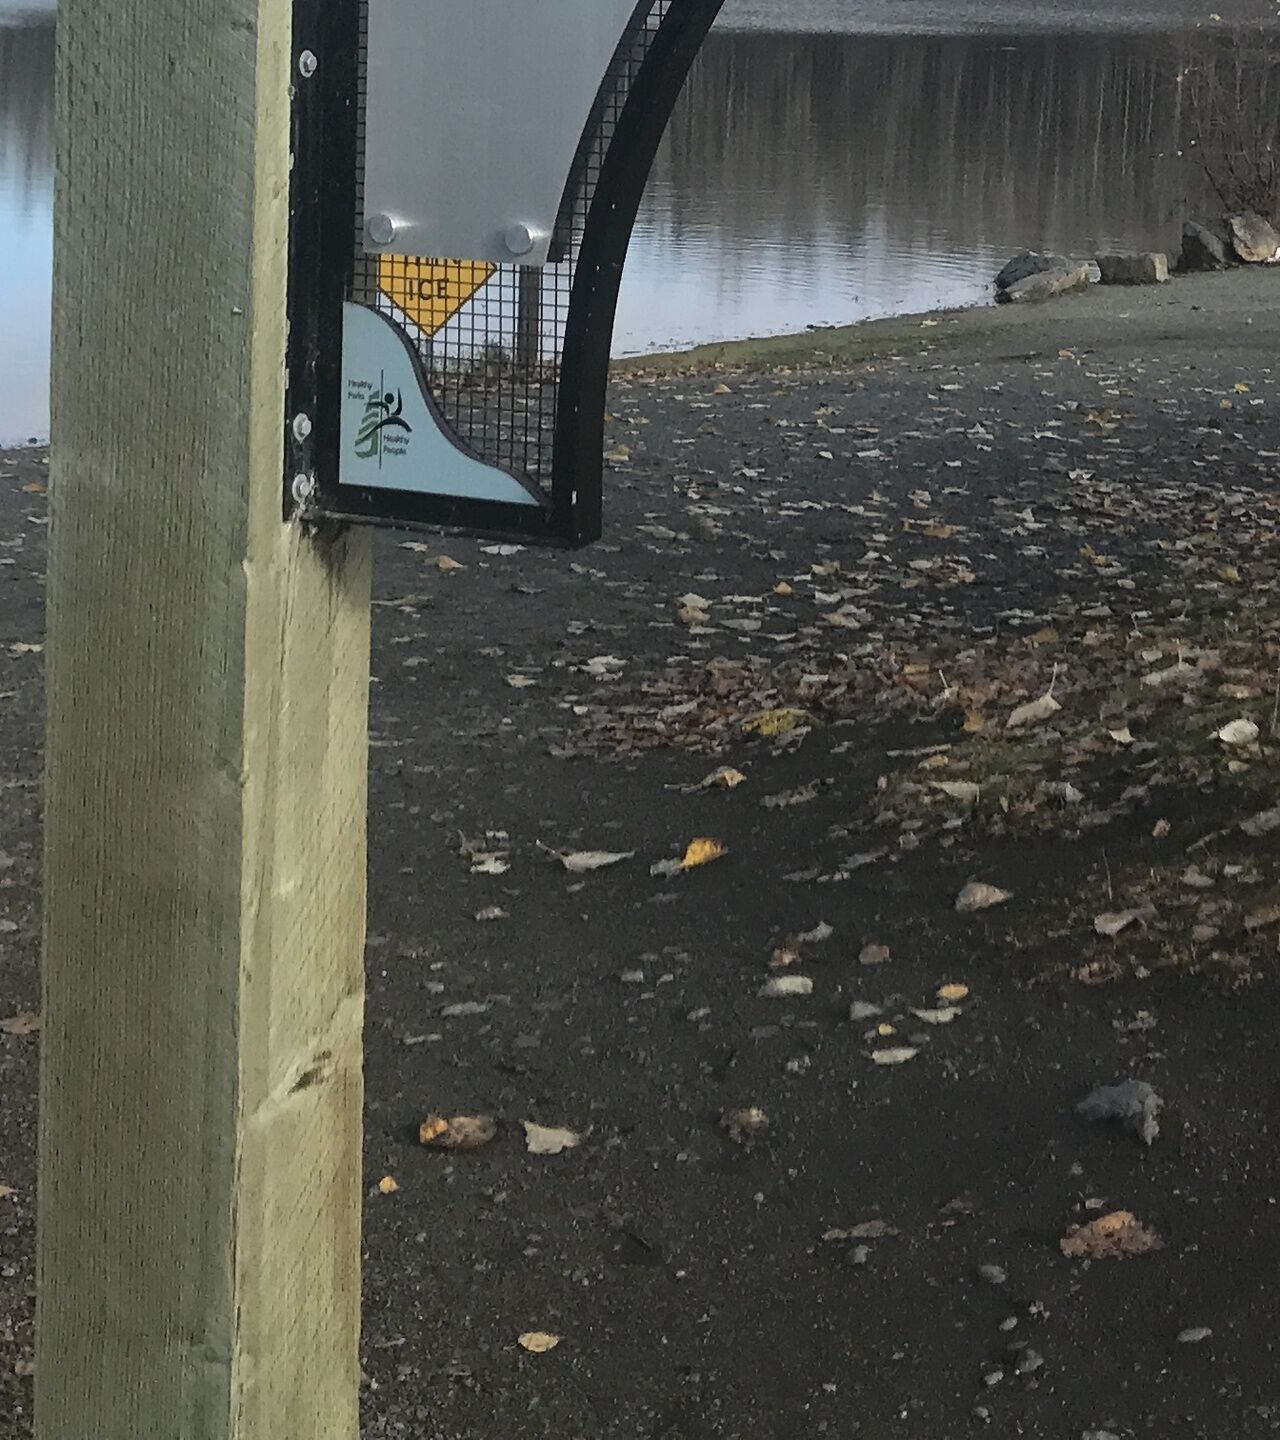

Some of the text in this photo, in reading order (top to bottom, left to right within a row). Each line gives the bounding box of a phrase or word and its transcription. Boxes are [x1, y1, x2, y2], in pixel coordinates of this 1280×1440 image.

[408, 277, 450, 301] ICE
[347, 379, 374, 391] Healthy
[383, 434, 410, 445] Healthy
